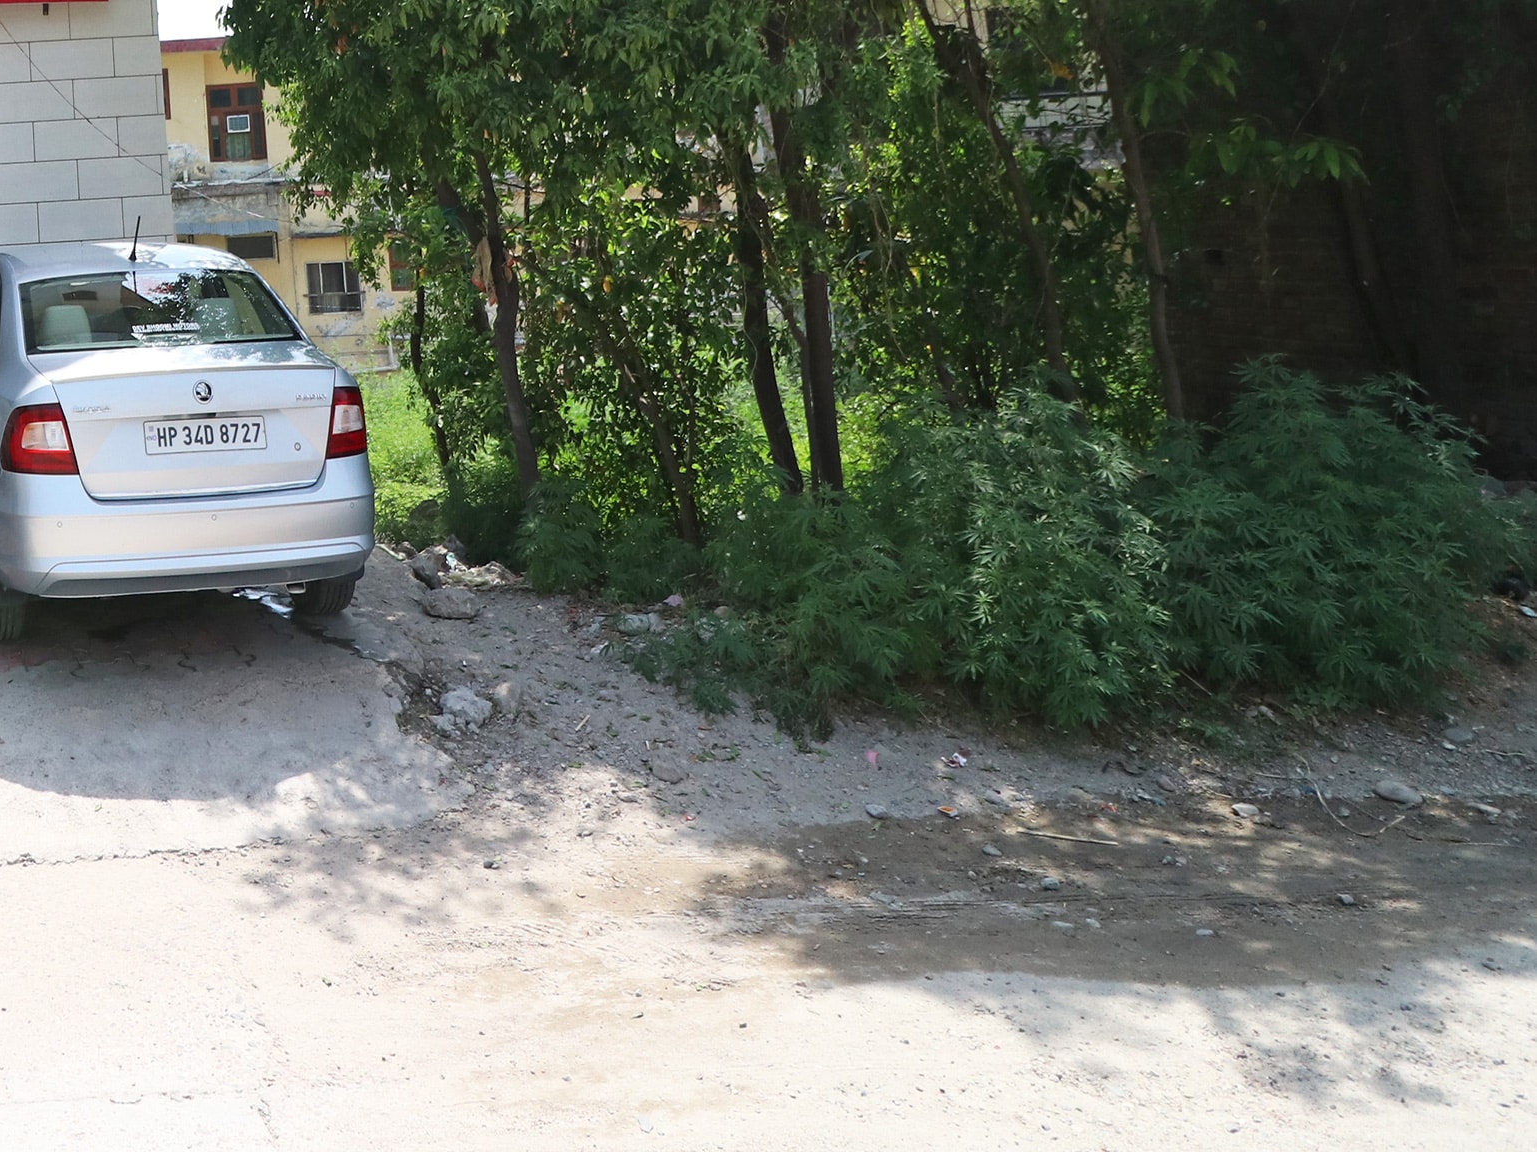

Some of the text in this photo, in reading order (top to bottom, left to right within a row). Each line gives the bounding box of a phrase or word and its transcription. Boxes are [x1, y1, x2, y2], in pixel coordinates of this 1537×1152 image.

[156, 422, 262, 448] HP 34D 8727
